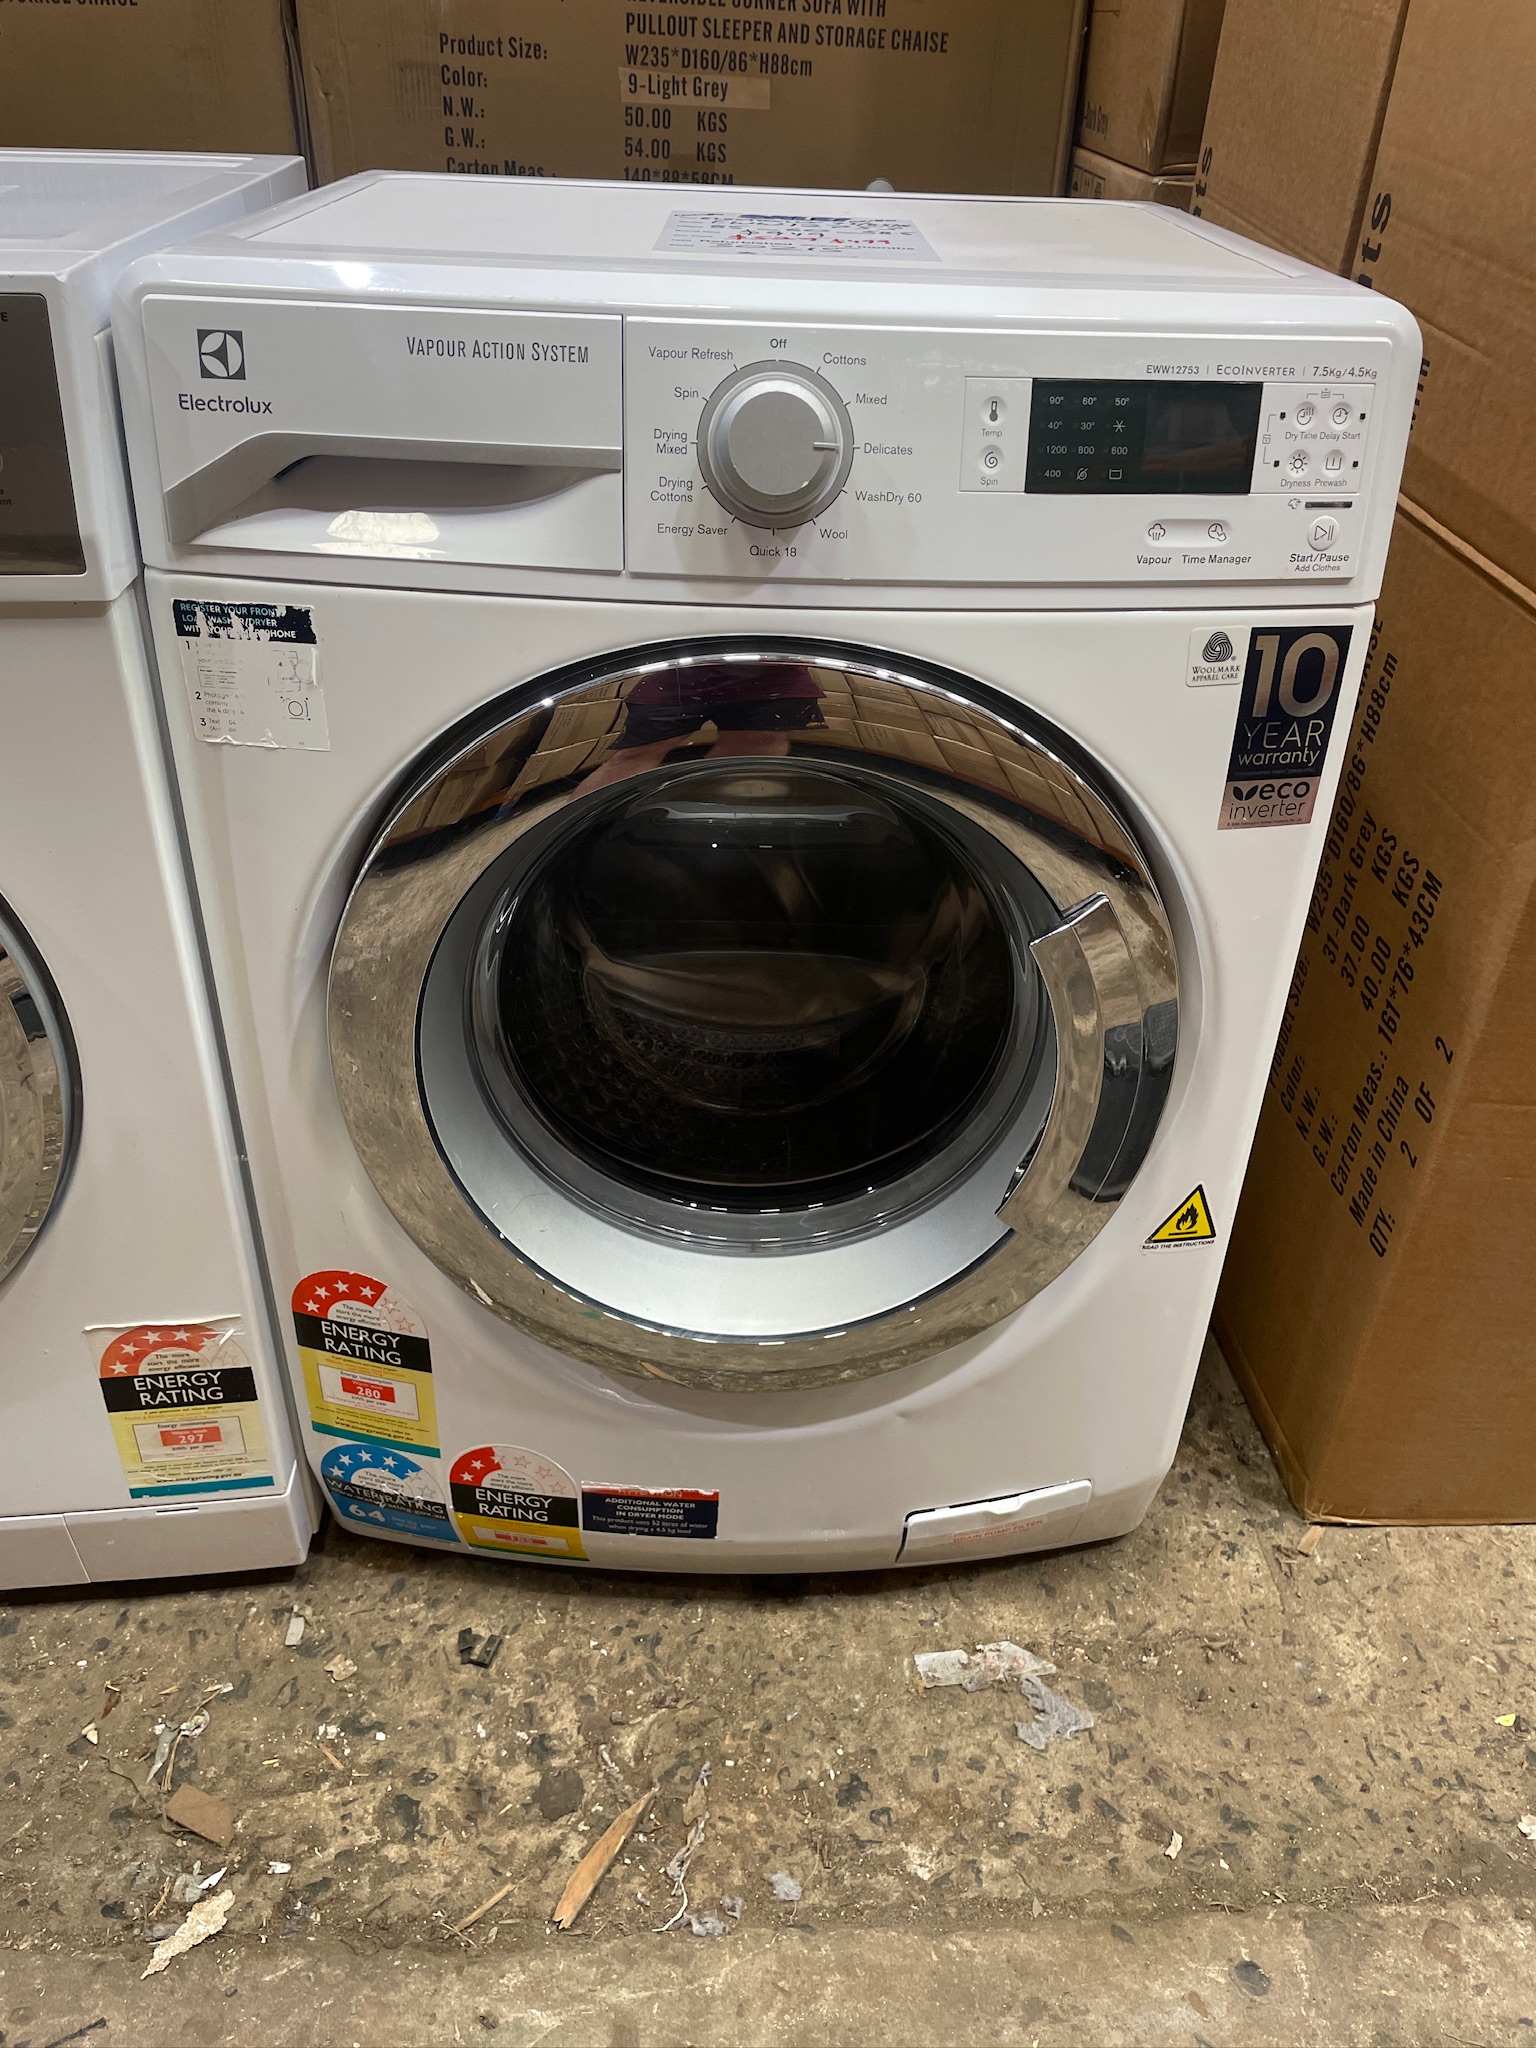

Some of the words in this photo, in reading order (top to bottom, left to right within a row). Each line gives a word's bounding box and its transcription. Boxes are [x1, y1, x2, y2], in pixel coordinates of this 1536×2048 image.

[848, 0, 886, 17] WITH
[626, 12, 698, 37] PULLOUT
[702, 17, 773, 43] SLEEPER
[777, 22, 810, 45] AND
[815, 24, 887, 50] STORAGE
[891, 29, 949, 53] CHAISE
[439, 33, 503, 58] Product
[508, 37, 548, 60] Size:
[441, 64, 488, 88] Color:
[628, 73, 687, 100] 9-Light
[693, 76, 728, 102] Grey
[443, 96, 485, 119] N.W.:
[625, 106, 672, 129] 50.00
[697, 111, 728, 133] KGS
[445, 127, 486, 149] G.W.:
[625, 137, 670, 160] 54.00
[696, 142, 727, 163] KGS
[446, 157, 499, 175] Carton
[770, 338, 787, 348] Off
[648, 346, 689, 361] Vapour
[691, 347, 733, 361] Refresh
[823, 352, 867, 366] Cottons
[1146, 364, 1200, 375] EWW12753
[674, 387, 699, 400] Spin
[855, 393, 887, 405] Mixed
[178, 393, 273, 415] Electrolux
[653, 429, 688, 444] Drying
[982, 428, 1003, 438] Temp
[1285, 432, 1298, 441] Dry
[1300, 432, 1318, 440] Time
[1319, 432, 1340, 441] Delay
[1342, 432, 1360, 440] Start
[656, 443, 688, 455] Mixed
[864, 443, 913, 456] Delicates
[1046, 446, 1067, 455] 1200
[1078, 446, 1095, 455] 800
[1111, 446, 1128, 455] 600
[1044, 469, 1061, 478] 400
[659, 477, 693, 491] Drying
[980, 477, 998, 487] Spin
[1280, 479, 1311, 489] Dryness
[1315, 479, 1347, 487] Prewash
[650, 491, 693, 503] Cottons
[855, 491, 905, 505] WashDry
[908, 493, 922, 503] 60
[657, 523, 694, 537] Energy
[697, 524, 728, 536] Saver
[820, 528, 848, 540] Wool
[749, 545, 781, 558] Quick
[785, 547, 797, 558] 18
[1290, 553, 1349, 563] Start/Pause
[1136, 555, 1172, 566] Vapour
[1182, 555, 1206, 564] Time
[1208, 555, 1251, 566] Manager
[1294, 564, 1309, 572] Add
[1312, 564, 1340, 572] Clothes
[222, 605, 248, 614] YOUR
[186, 640, 190, 650] 1
[1191, 665, 1241, 675] WOOLMARK
[1191, 674, 1220, 682] APPAREL
[1252, 632, 1340, 718] 10
[195, 691, 202, 700] 2
[200, 717, 206, 726] 3
[1243, 720, 1325, 750] YEAR
[1238, 746, 1320, 766] warranty
[1259, 781, 1310, 800] eco
[1229, 800, 1305, 820] inverter
[1323, 872, 1360, 965] 31-Dark
[1349, 809, 1377, 869] Grey
[1341, 914, 1370, 989] 37.00
[1371, 828, 1398, 884] KGS
[1359, 936, 1392, 1012] 40.00
[1390, 850, 1421, 909] KGS
[1434, 1035, 1454, 1065] 2
[1280, 1055, 1306, 1114] Color:
[1376, 1075, 1410, 1144] China
[1414, 1081, 1436, 1125] OF
[1295, 1086, 1321, 1142] N.W.:
[1330, 1124, 1363, 1197] Carton
[1352, 1050, 1388, 1126] Meas.:
[1312, 1114, 1338, 1168] G.W.:
[1372, 1141, 1387, 1171] in
[1400, 1141, 1417, 1169] 2
[1349, 1164, 1378, 1227] Made
[1369, 1207, 1396, 1258] QTY:
[1173, 1239, 1215, 1248] INSTRUCTIONS
[358, 1319, 381, 1327] efficient
[321, 1320, 400, 1348] ENERGY
[324, 1337, 401, 1365] RATING
[133, 1371, 221, 1391] ENERGY
[140, 1387, 224, 1406] RATING
[356, 1386, 381, 1399] 280
[178, 1434, 204, 1445] 297
[325, 1478, 380, 1502] WATER
[385, 1495, 444, 1514] RATING
[475, 1488, 553, 1509] ENERGY
[605, 1497, 661, 1507] ADDITIONAL
[662, 1501, 696, 1509] WATER
[348, 1504, 386, 1522] 64
[479, 1503, 548, 1522] RATING
[617, 1504, 684, 1514] CONSUMPTION
[628, 1511, 657, 1519] DRYER
[607, 1516, 634, 1525] product
[661, 1520, 679, 1528] litres
[953, 1533, 981, 1543] DRAIN
[985, 1526, 1011, 1537] PUMP
[1013, 1519, 1043, 1531] FILTER
